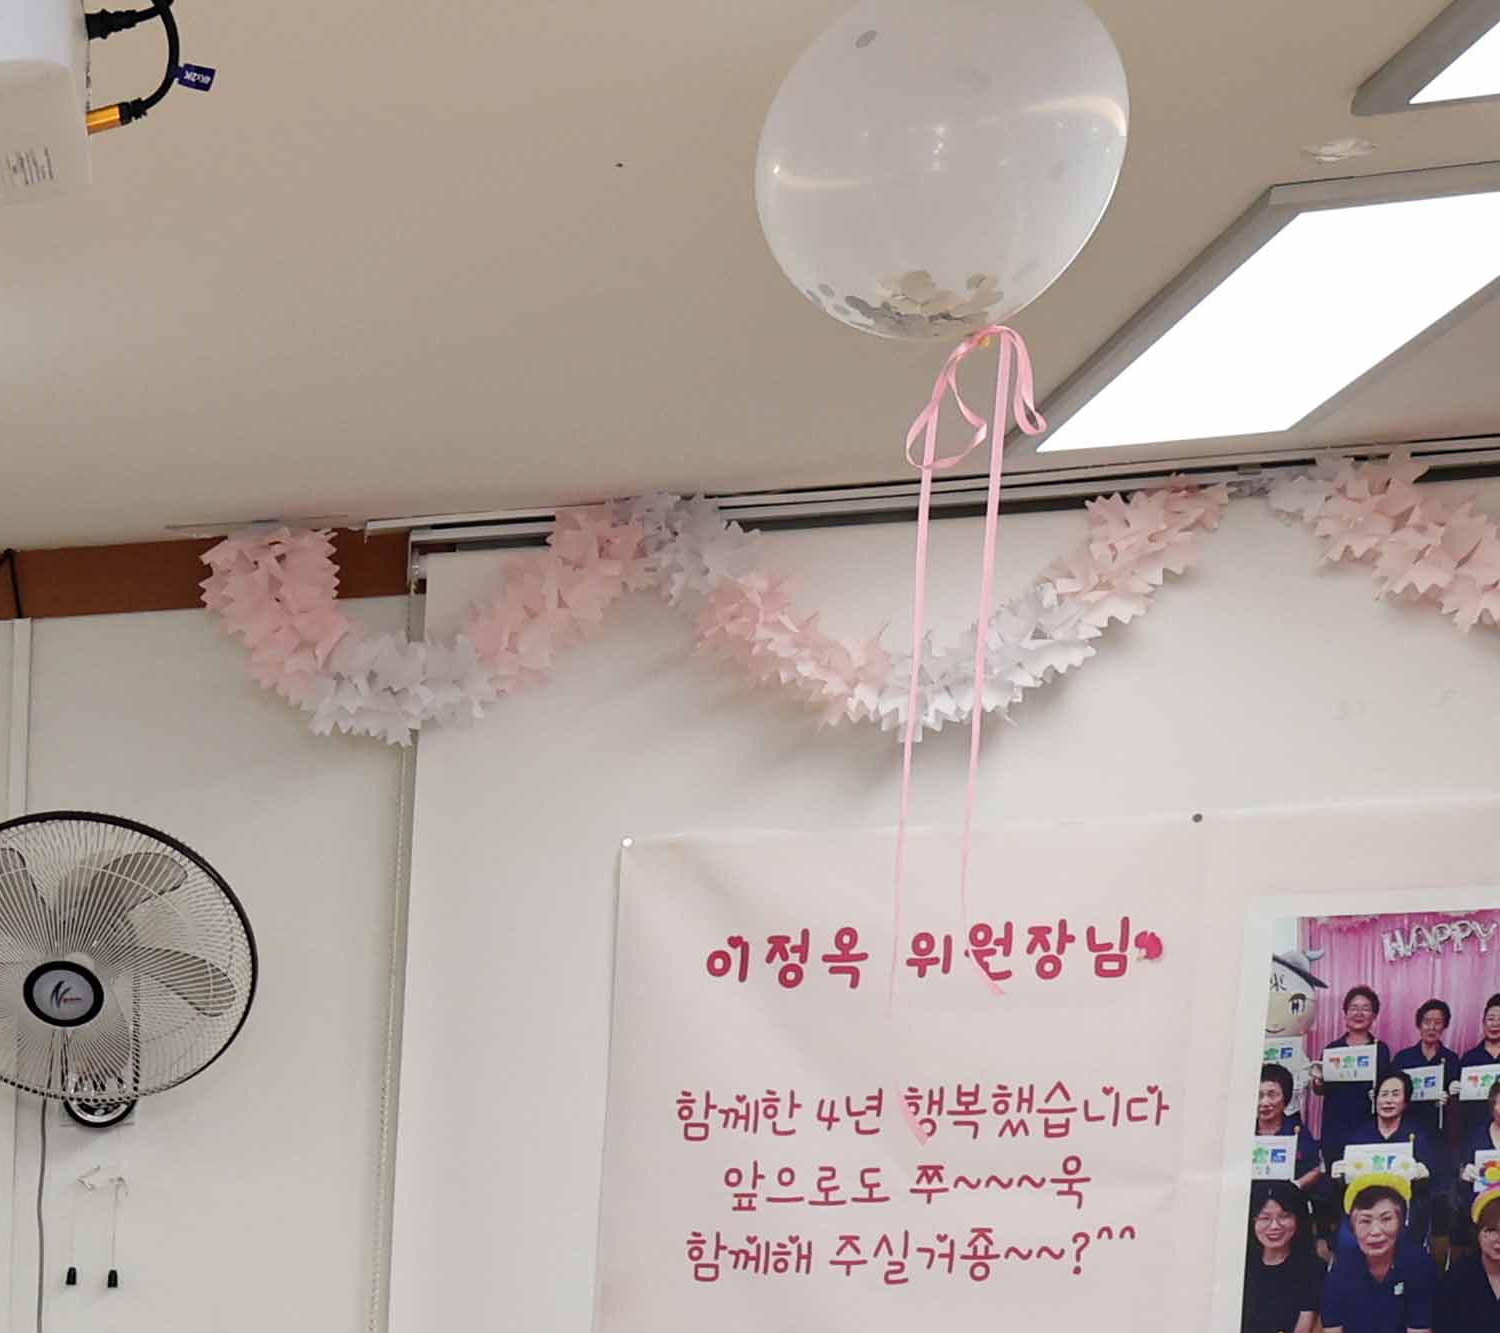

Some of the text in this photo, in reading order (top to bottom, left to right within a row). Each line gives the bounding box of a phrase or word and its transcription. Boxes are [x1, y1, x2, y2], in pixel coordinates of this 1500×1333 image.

[705, 917, 1133, 990] 이정옥 위원장님
[1381, 919, 1497, 965] HAPPY
[675, 1080, 1170, 1143] 함께한 4년 행복했습니다
[723, 1160, 891, 1212] 앞으로도
[685, 1230, 813, 1283] 함께해
